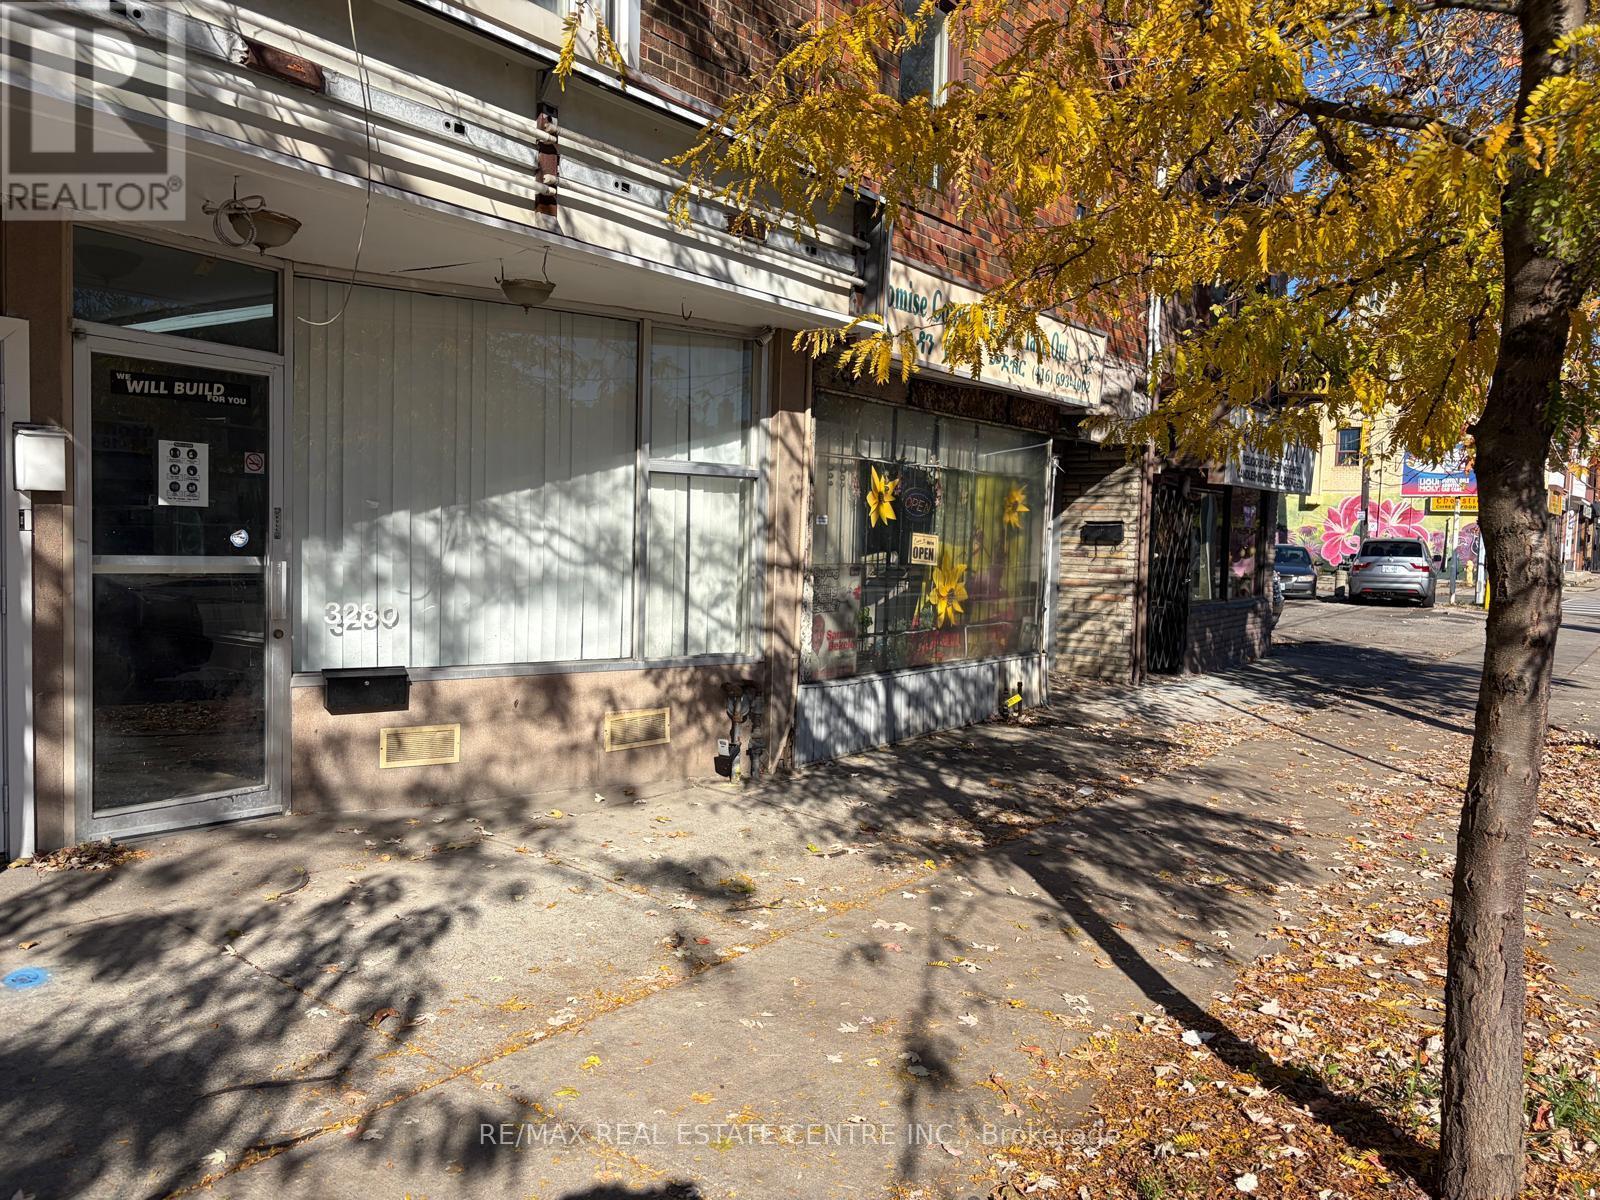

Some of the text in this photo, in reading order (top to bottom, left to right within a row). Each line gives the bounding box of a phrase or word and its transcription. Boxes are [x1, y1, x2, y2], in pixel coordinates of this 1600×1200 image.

[1051, 332, 1069, 361] Out
[116, 372, 131, 381] WE
[126, 380, 225, 396] WILL BUILD
[207, 394, 247, 405] FOR YOU
[905, 497, 932, 514] OPEN
[913, 546, 934, 561] OPEN
[324, 602, 398, 625] 3280
